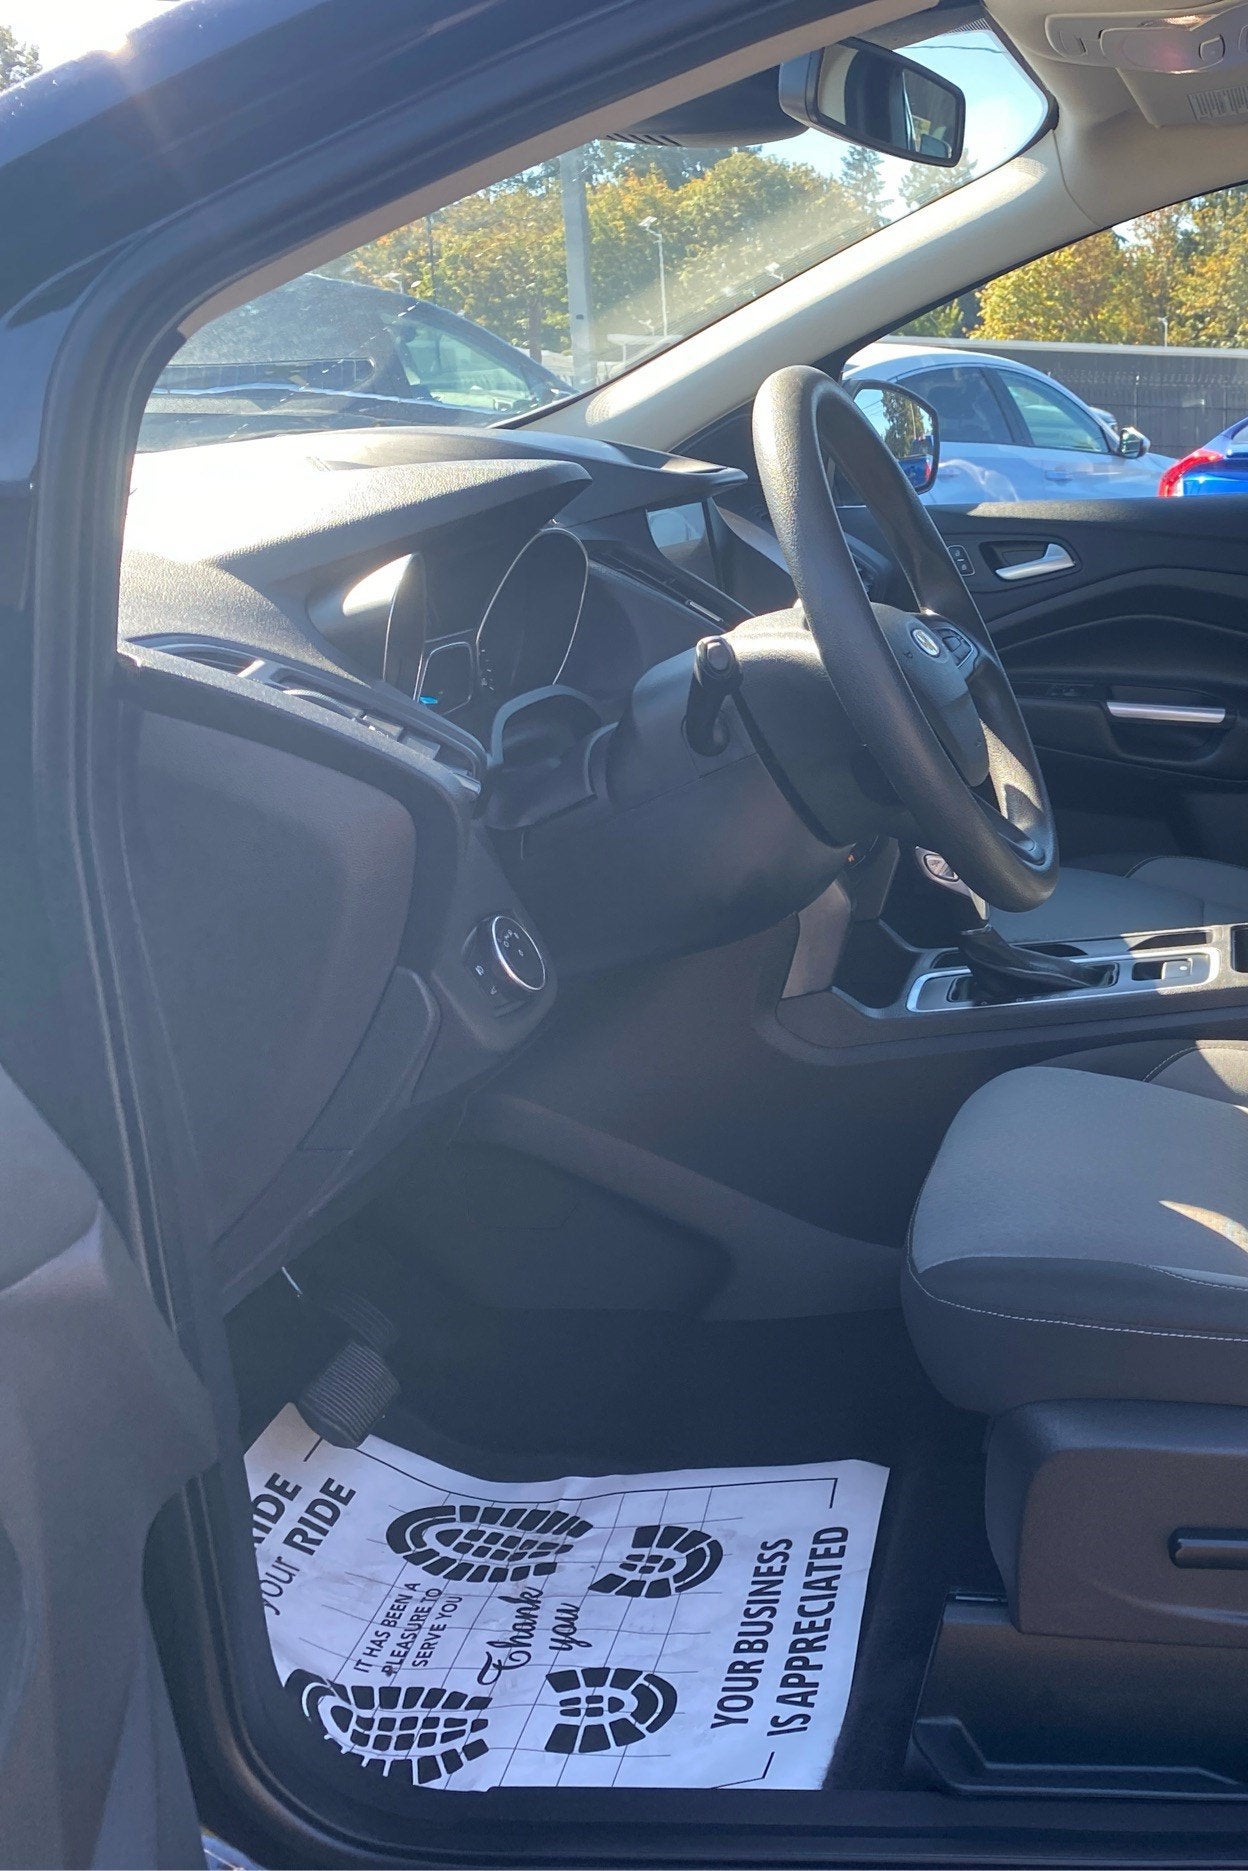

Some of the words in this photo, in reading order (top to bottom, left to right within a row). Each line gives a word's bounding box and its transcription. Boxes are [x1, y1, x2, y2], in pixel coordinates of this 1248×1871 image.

[252, 1472, 303, 1545] IDE
[282, 1477, 357, 1556] RIDE
[381, 1594, 413, 1628] BEEN
[404, 1582, 422, 1592] A
[733, 1538, 793, 1654] BUSINESS
[776, 1526, 849, 1708] APPRECIATED
[363, 1630, 391, 1657] HAS
[381, 1605, 431, 1676] PLEASURE
[419, 1588, 443, 1607] TO
[412, 1623, 447, 1667] SERVE
[435, 1596, 463, 1621] YOU
[477, 1586, 543, 1685] Thank
[549, 1602, 592, 1651] you
[354, 1658, 373, 1673] IT
[710, 1659, 765, 1729] YOUR
[767, 1713, 812, 1737] IS
